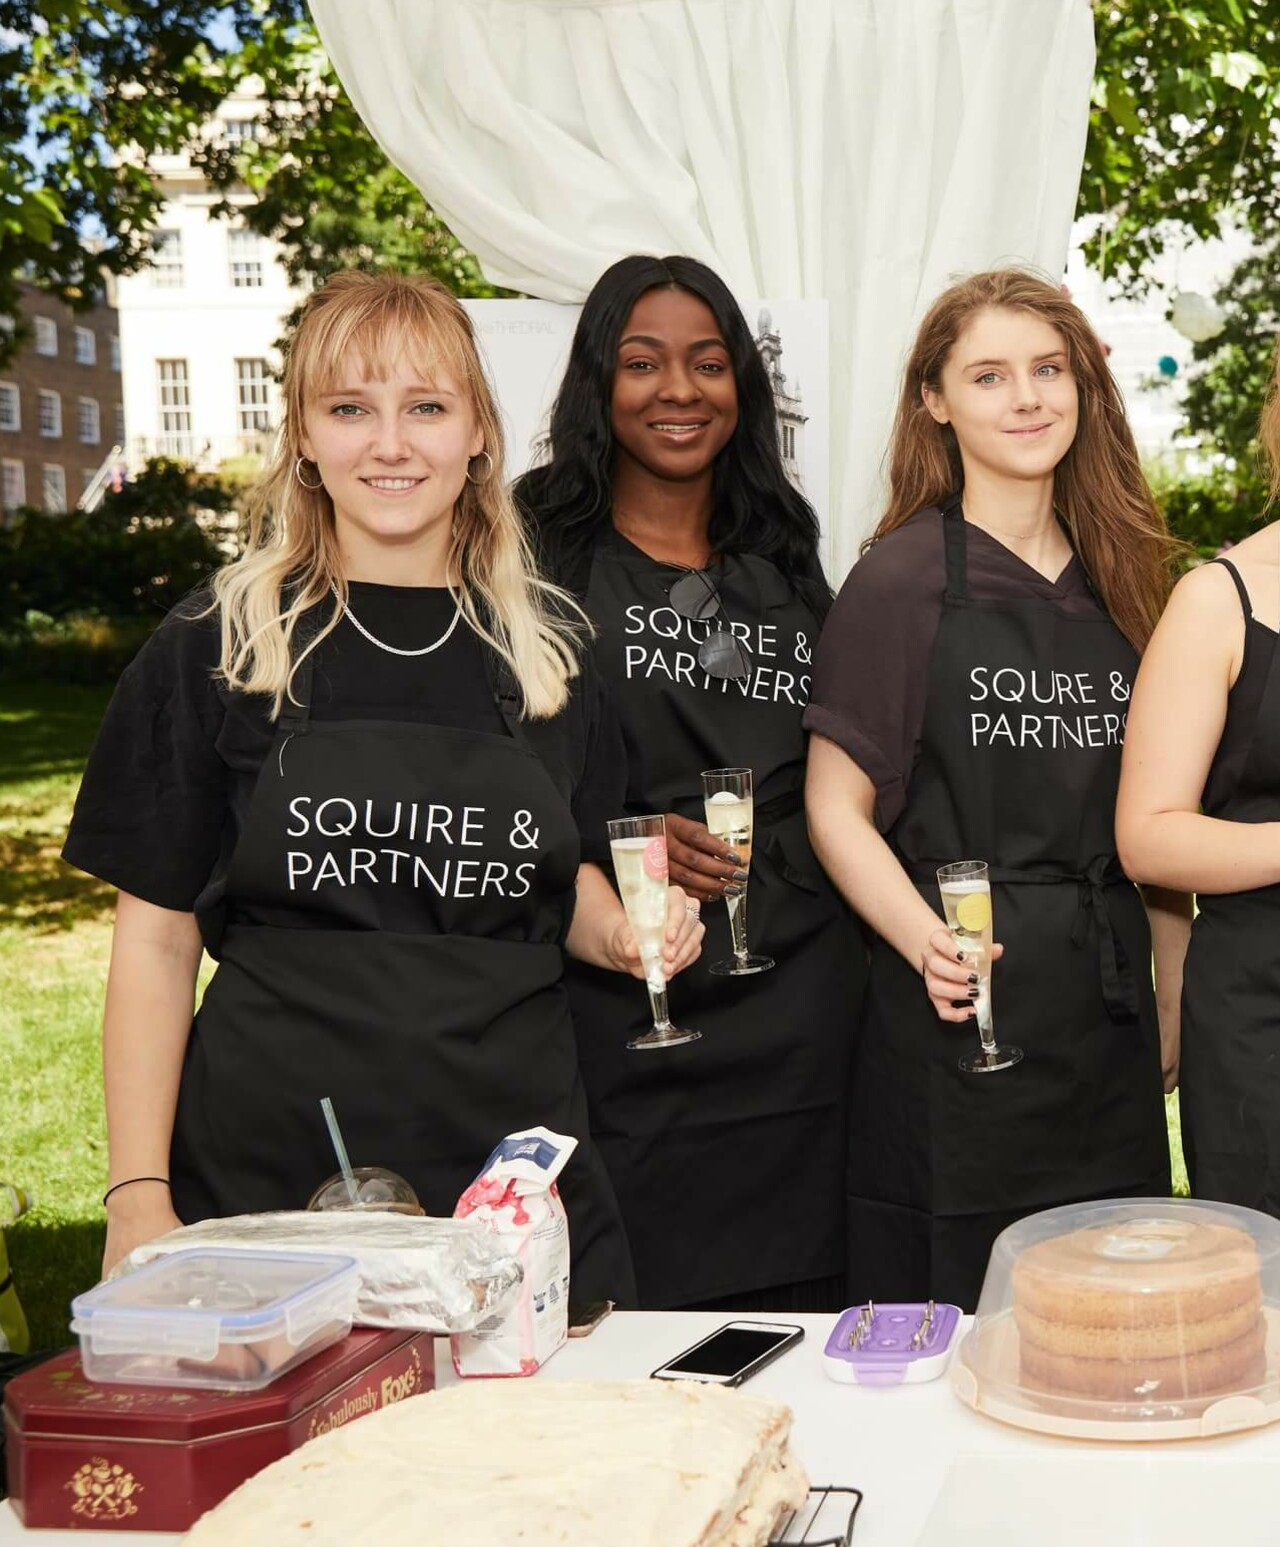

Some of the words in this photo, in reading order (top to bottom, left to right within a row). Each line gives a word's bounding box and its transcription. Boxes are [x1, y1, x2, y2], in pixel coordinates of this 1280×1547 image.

[794, 631, 812, 665] &
[1109, 671, 1131, 702] &
[286, 796, 486, 847] SQUIRE
[508, 808, 540, 849] &
[286, 847, 536, 898] PARTNERS
